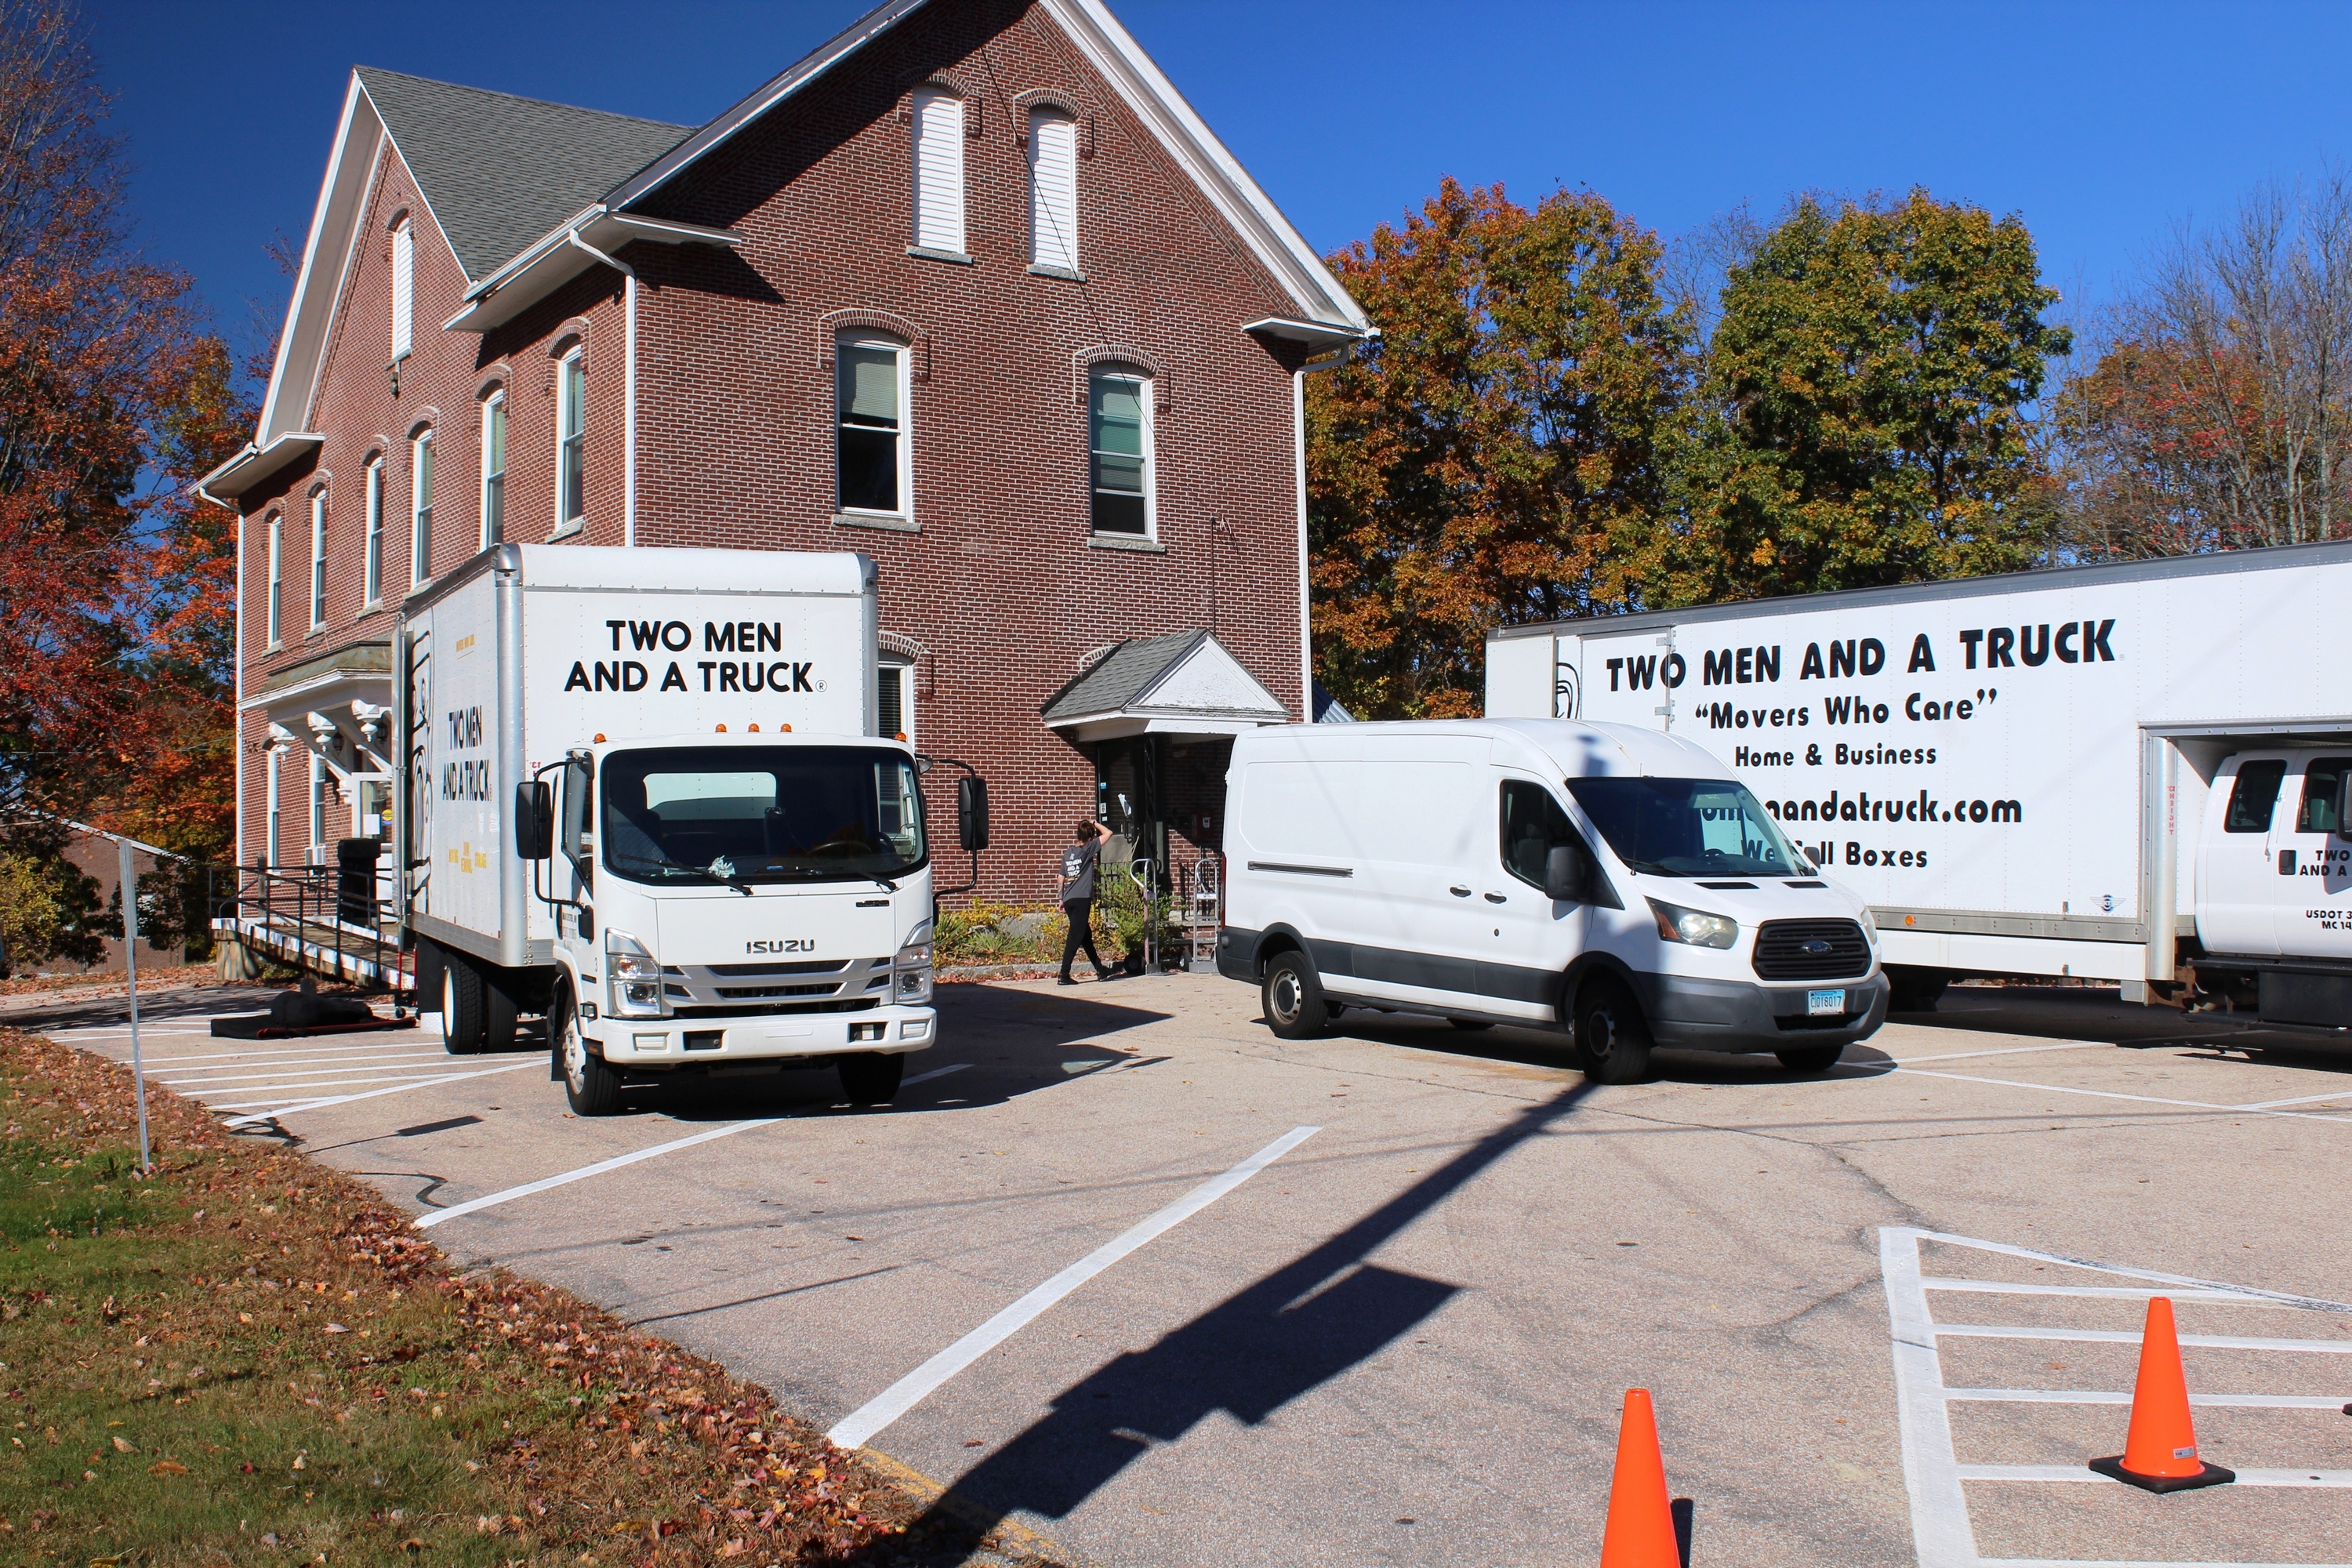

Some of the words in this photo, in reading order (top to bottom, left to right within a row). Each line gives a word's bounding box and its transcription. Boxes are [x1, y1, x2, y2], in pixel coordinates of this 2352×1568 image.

[606, 620, 691, 652] TWO
[705, 621, 782, 652] MEN
[1606, 652, 1686, 692] TWO
[1703, 645, 1781, 686] MEN
[1799, 637, 1886, 681] AND
[1907, 633, 1936, 673] A
[1959, 619, 2117, 670] TRUCK
[564, 661, 648, 692] AND
[659, 661, 688, 692] A
[1824, 695, 1889, 725] Who
[448, 710, 464, 750] TWO
[466, 705, 482, 748] MEN
[1735, 746, 1795, 768] Home
[1805, 743, 1823, 766] &
[1835, 742, 1937, 765] Business
[443, 762, 457, 800] AND
[459, 762, 464, 800] A
[465, 759, 489, 801] TRUCK
[1846, 841, 1928, 868] Boxes
[2315, 850, 2350, 862] TWO
[2299, 865, 2330, 877] AND
[2337, 865, 2347, 877] A
[2306, 909, 2343, 919] USDOT
[2321, 920, 2338, 930] MC
[746, 939, 815, 954] ISUZU
